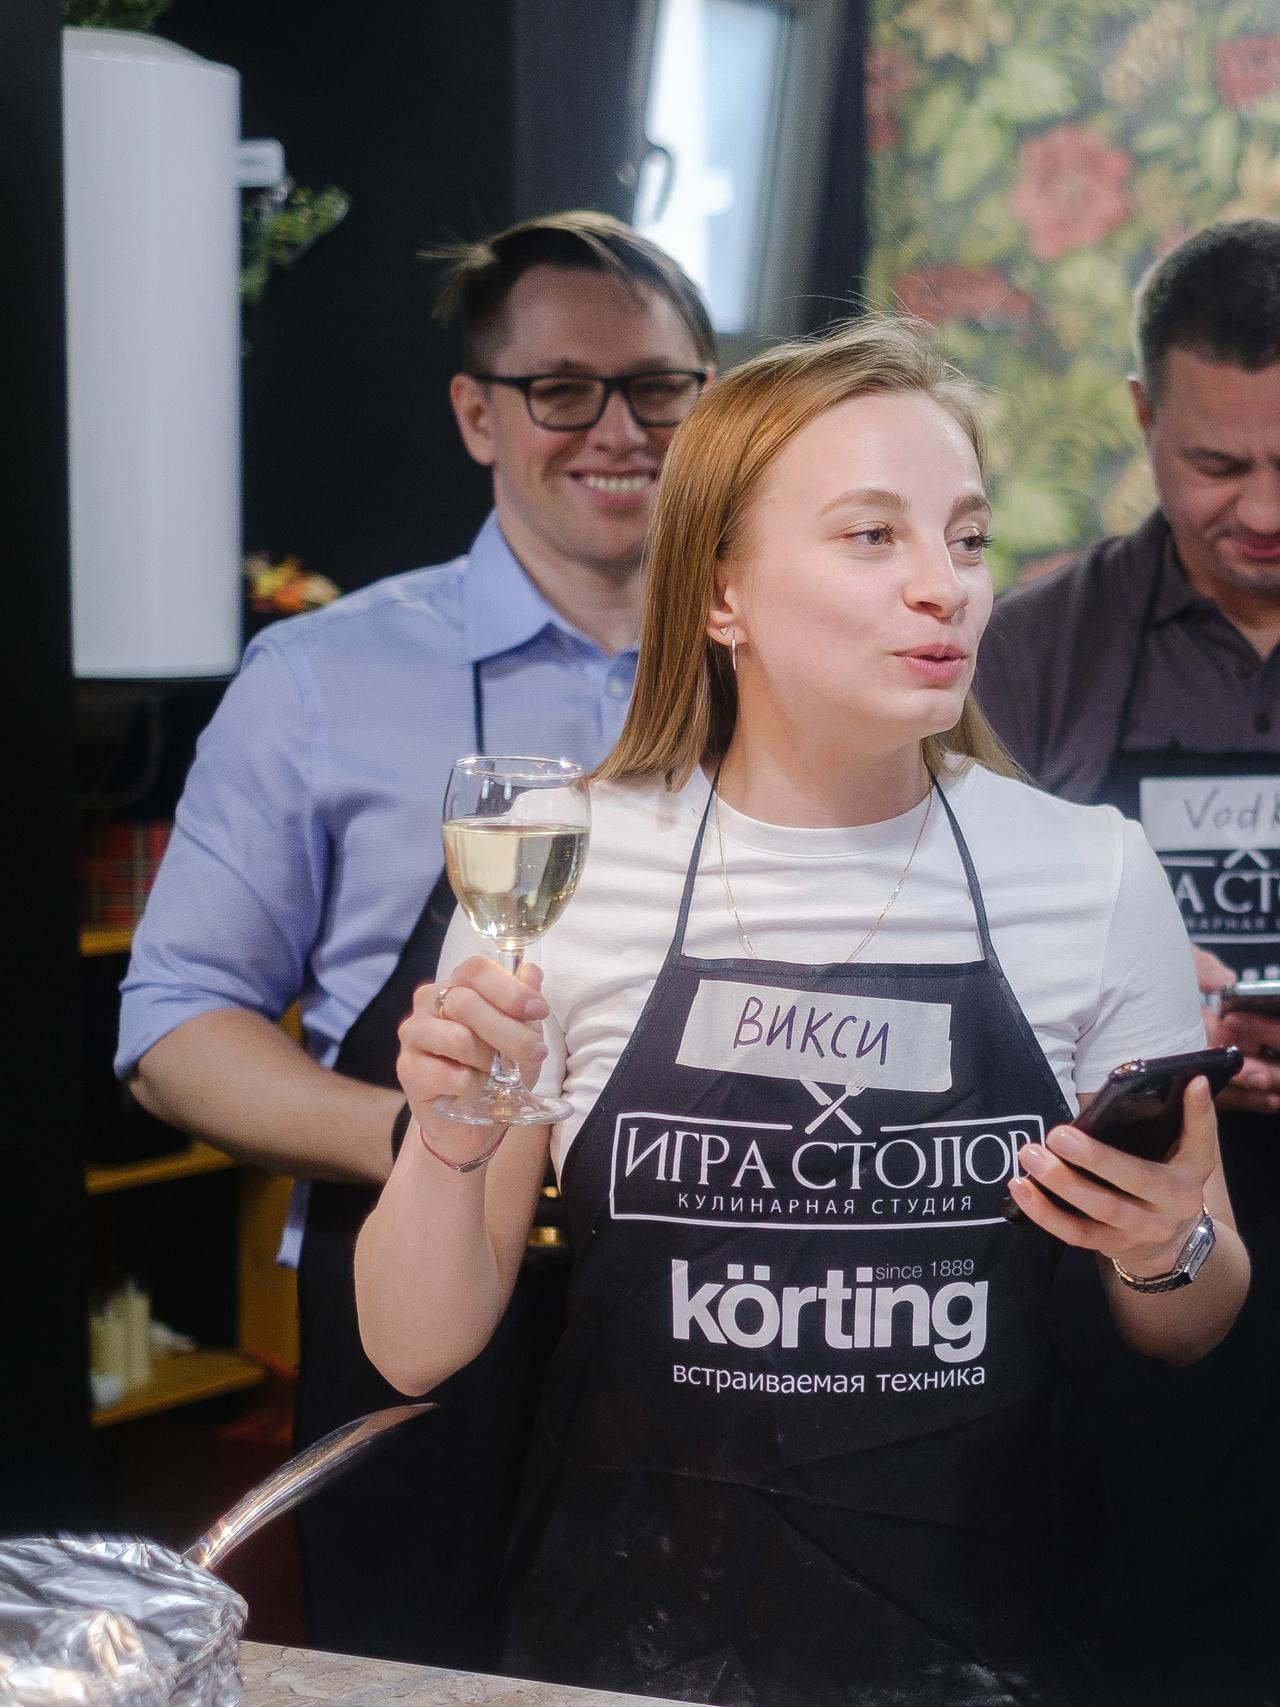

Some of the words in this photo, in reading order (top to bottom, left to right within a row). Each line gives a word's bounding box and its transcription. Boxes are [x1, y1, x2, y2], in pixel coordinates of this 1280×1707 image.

[733, 996, 890, 1066] ВИКСИ
[625, 1127, 776, 1189] ИГРА
[678, 1193, 855, 1215] КУЛИНАРНАЯ
[872, 1195, 973, 1215] СТУДИЯ
[875, 1264, 923, 1280] since
[929, 1258, 975, 1278] 1889
[672, 1259, 989, 1363] körting
[673, 1363, 866, 1394] встраиваемая
[875, 1366, 986, 1392] техника
